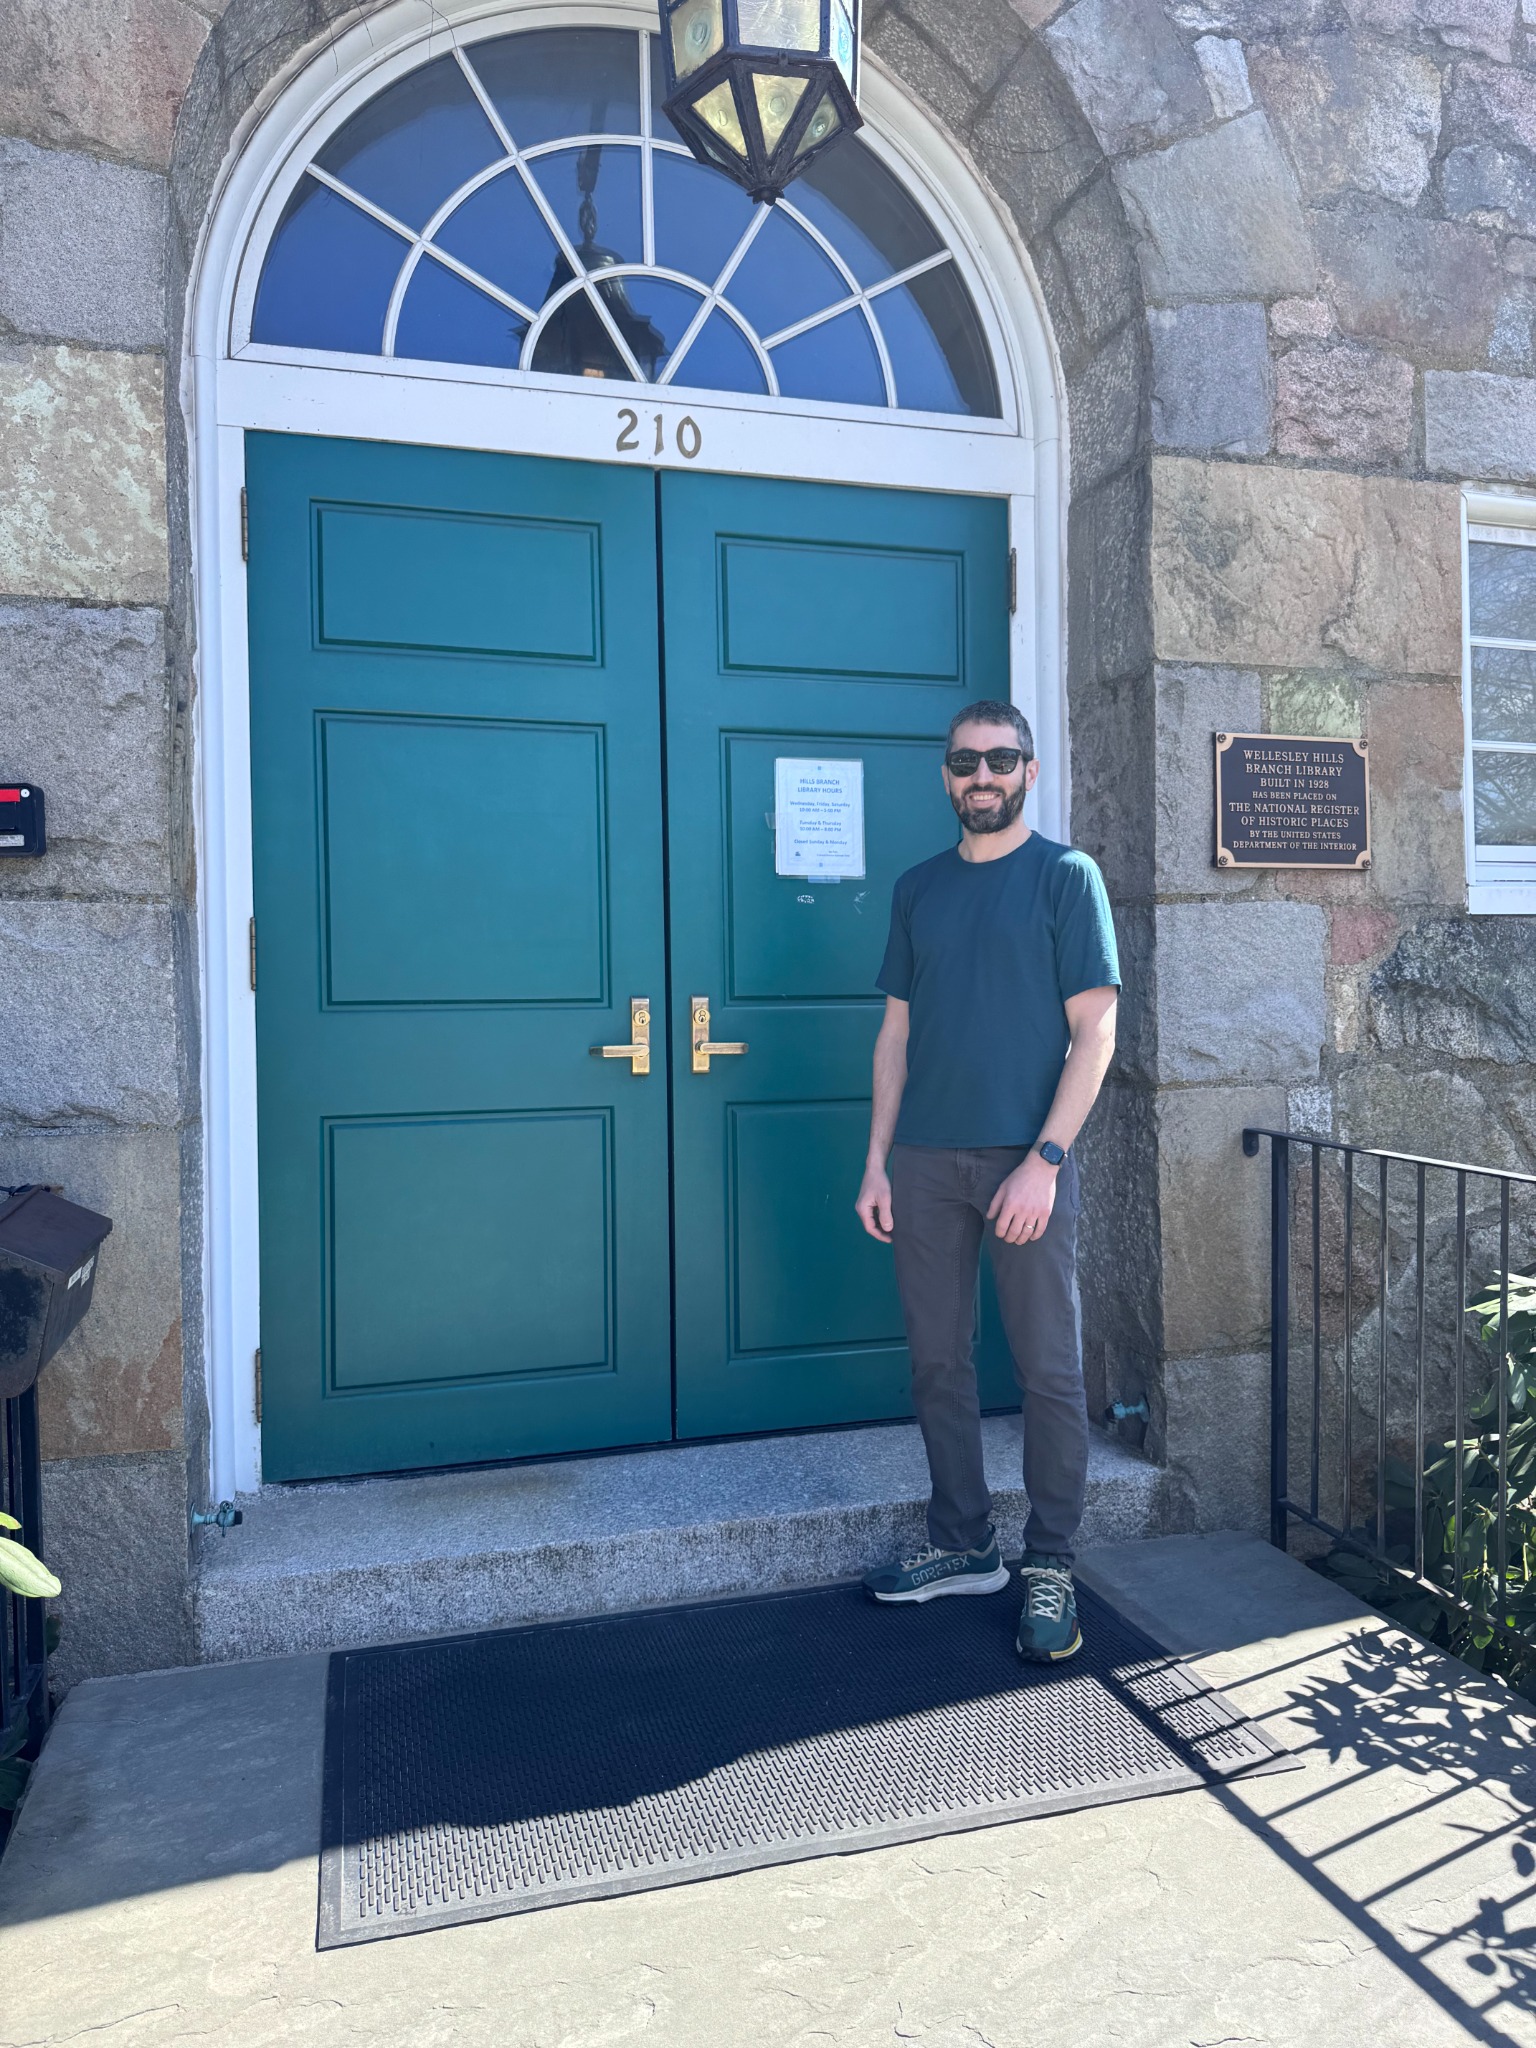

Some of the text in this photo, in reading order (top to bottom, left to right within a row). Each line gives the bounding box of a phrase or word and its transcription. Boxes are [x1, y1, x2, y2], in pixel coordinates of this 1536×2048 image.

[616, 408, 702, 459] 210
[1244, 750, 1344, 763] WELLESLEY HILLS
[1246, 764, 1342, 776] BRANCH LIBRARY
[1260, 778, 1329, 788] BUILT IN 1928
[1229, 803, 1360, 815] THE NATIONAL REGISTER
[1241, 816, 1349, 828] OF HISTORIC PLACES
[1233, 841, 1287, 849] DEPARTMENT
[911, 1555, 970, 1586] GORE-TEX
